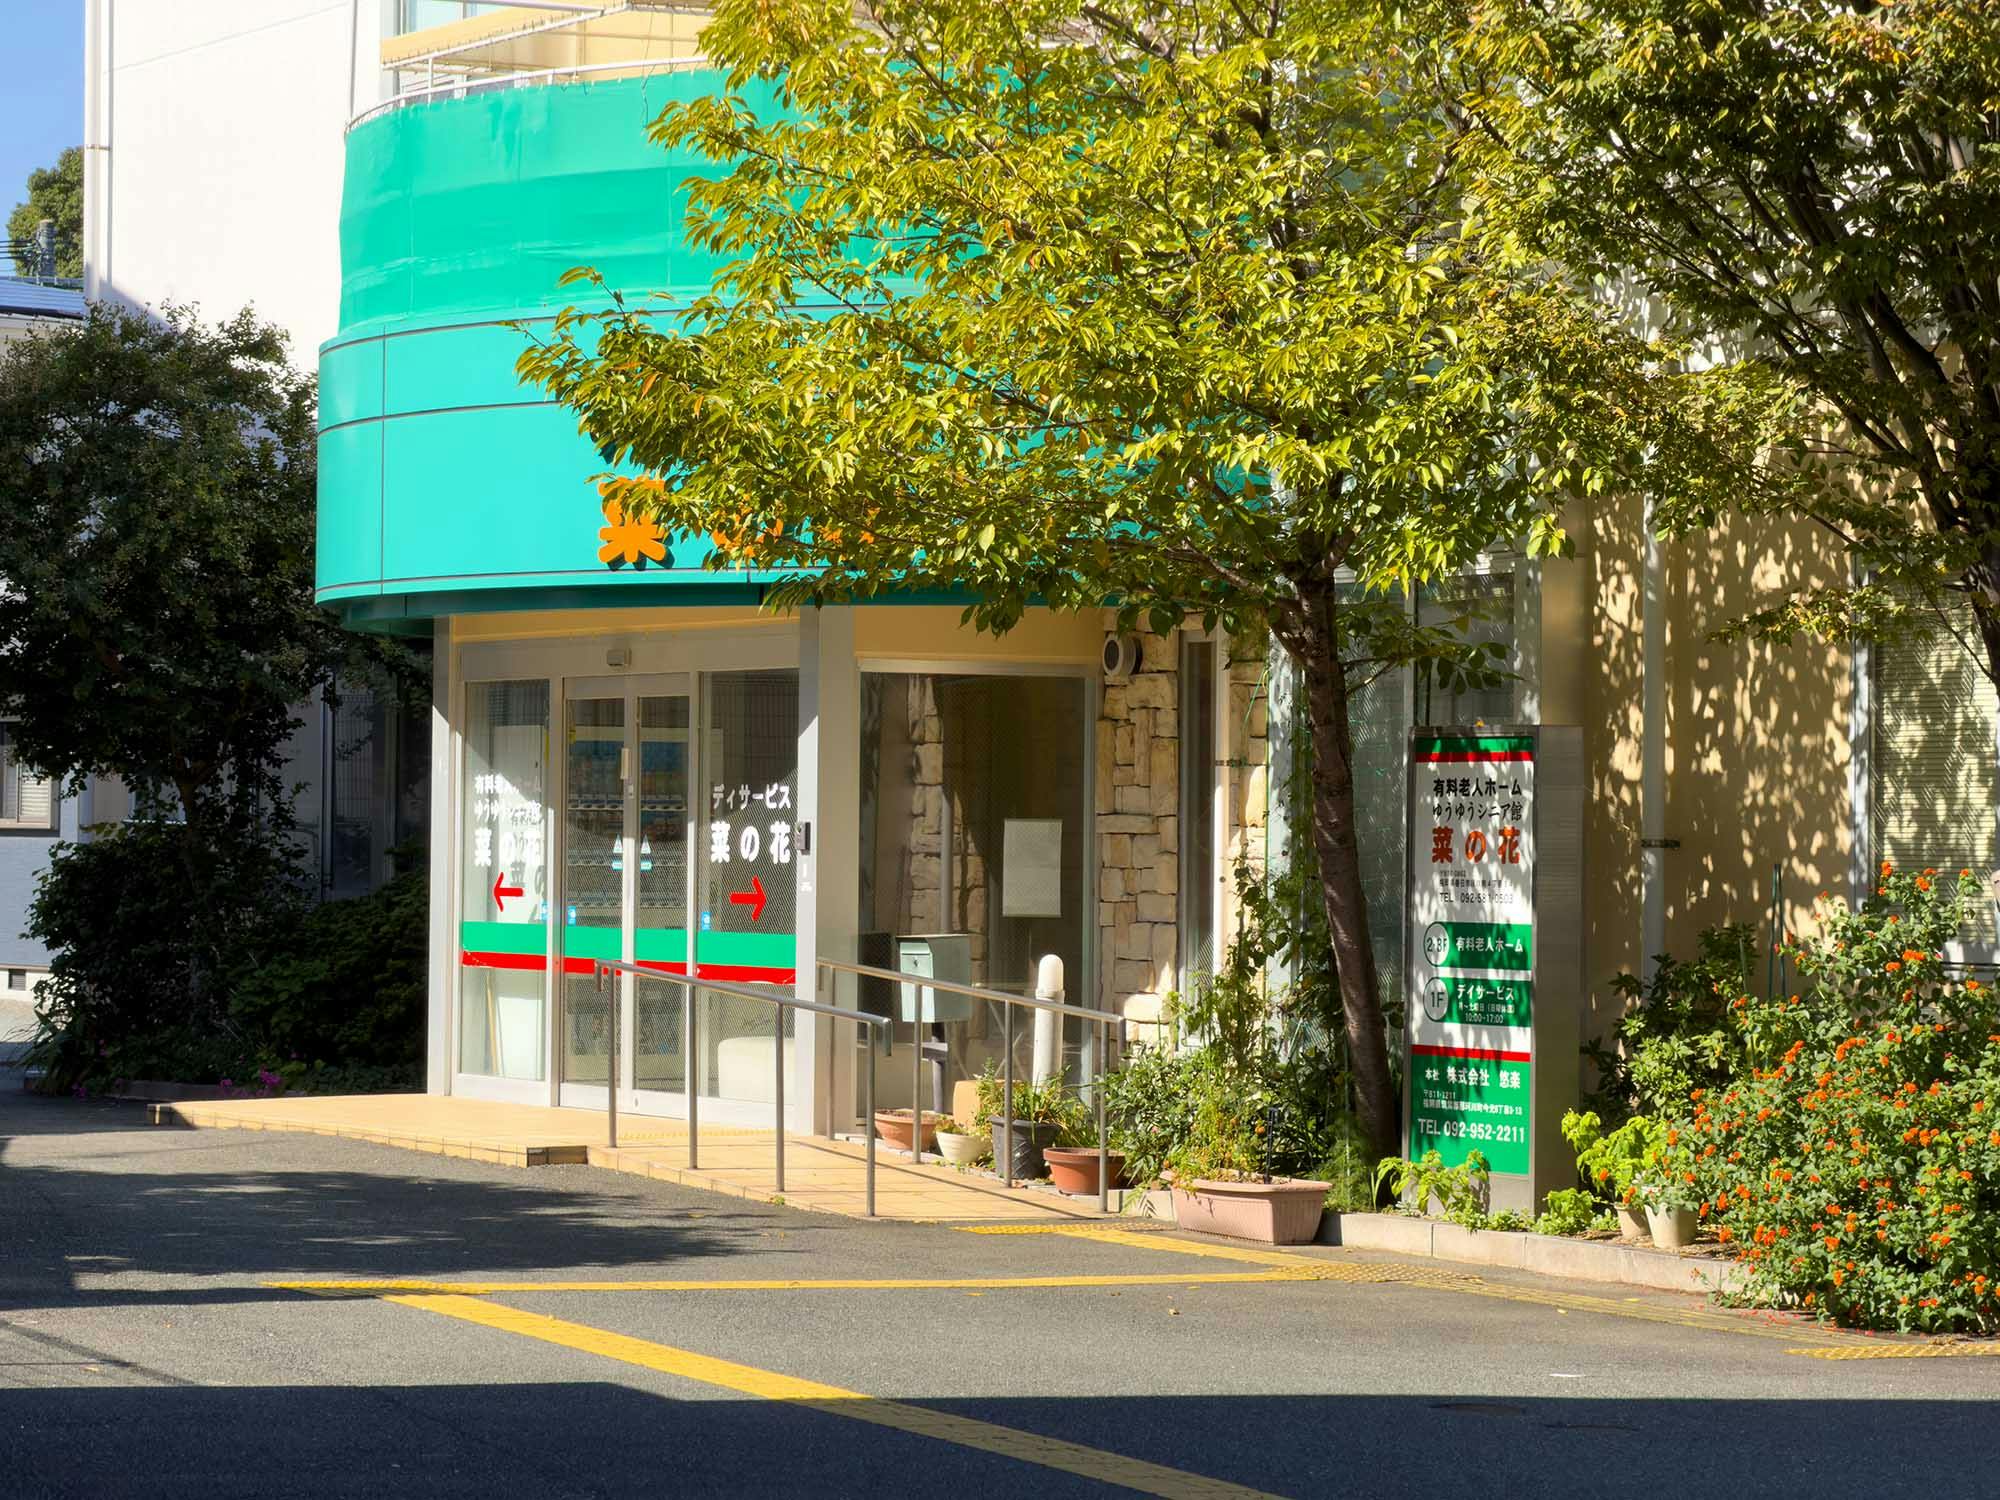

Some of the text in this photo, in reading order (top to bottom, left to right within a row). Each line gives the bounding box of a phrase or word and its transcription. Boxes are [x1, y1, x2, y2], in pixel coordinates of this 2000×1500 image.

[1433, 778, 1523, 797] 有料老人ホーム
[1432, 802, 1523, 821] ゆうゆうシニア館
[711, 821, 791, 864] 菜の花
[1432, 825, 1521, 864] 菜の花
[1440, 892, 1454, 903] TEL
[1456, 936, 1523, 953] 有料老人ホーム
[1431, 991, 1444, 1008] 1F
[1457, 984, 1515, 1001] デイサービス
[1425, 1068, 1439, 1081] 本社
[1447, 1066, 1490, 1087] 株式会社
[1418, 1118, 1525, 1143] TEL 092-952-2211
